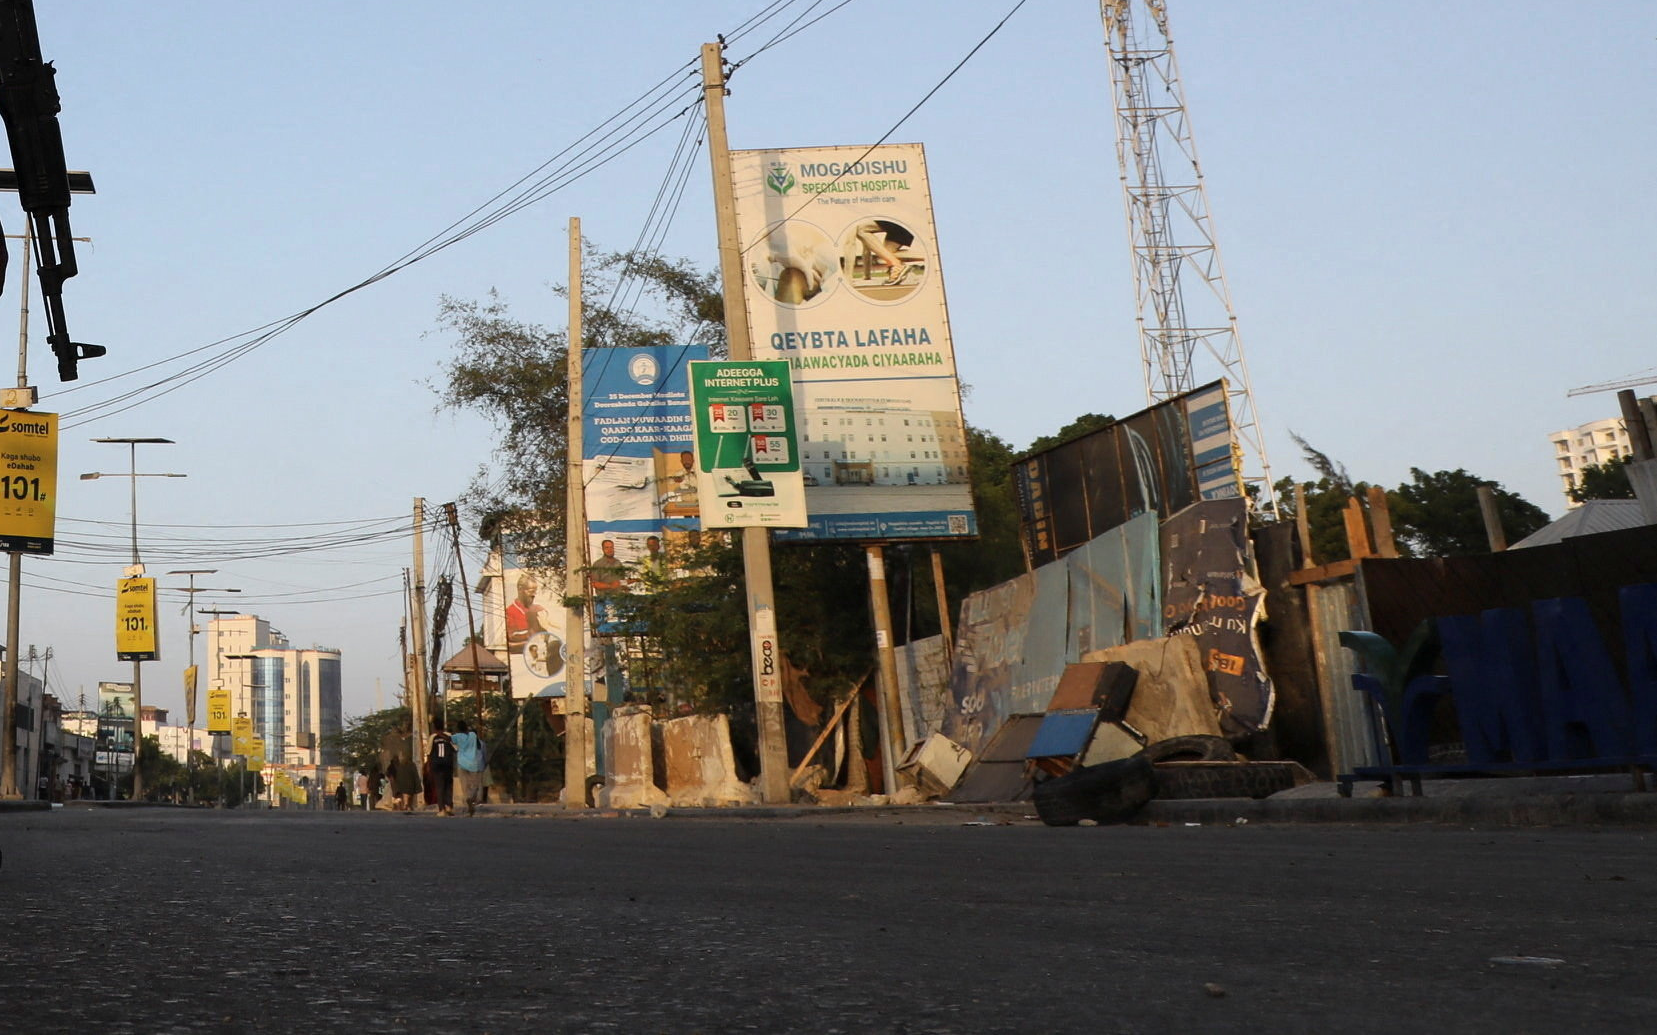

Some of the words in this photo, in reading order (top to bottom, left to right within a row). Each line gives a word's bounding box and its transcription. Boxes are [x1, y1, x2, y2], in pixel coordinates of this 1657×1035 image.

[800, 160, 908, 179] MOGADISHU
[802, 180, 859, 195] SPECIALIST
[860, 179, 911, 192] HOSPITAL
[816, 197, 830, 205] The
[852, 196, 860, 204] of
[860, 195, 881, 204] Health
[770, 330, 849, 351] QEYBTA
[854, 327, 932, 347] LAFAHA
[777, 355, 869, 371] AAWACYADA
[873, 351, 944, 368] CIYAARAHA
[716, 368, 764, 378] ADEEGGA
[704, 378, 752, 387] INTERNET
[753, 377, 779, 387] PLUS
[727, 409, 738, 417] 20
[766, 408, 777, 417] 30
[594, 417, 631, 426] FADLAN
[632, 416, 684, 425] MUWAADIN
[11, 421, 49, 435] somtel
[769, 440, 781, 448] 55
[0, 452, 19, 461] Kaga
[20, 453, 41, 462] shubo
[6, 462, 35, 471] eDahab
